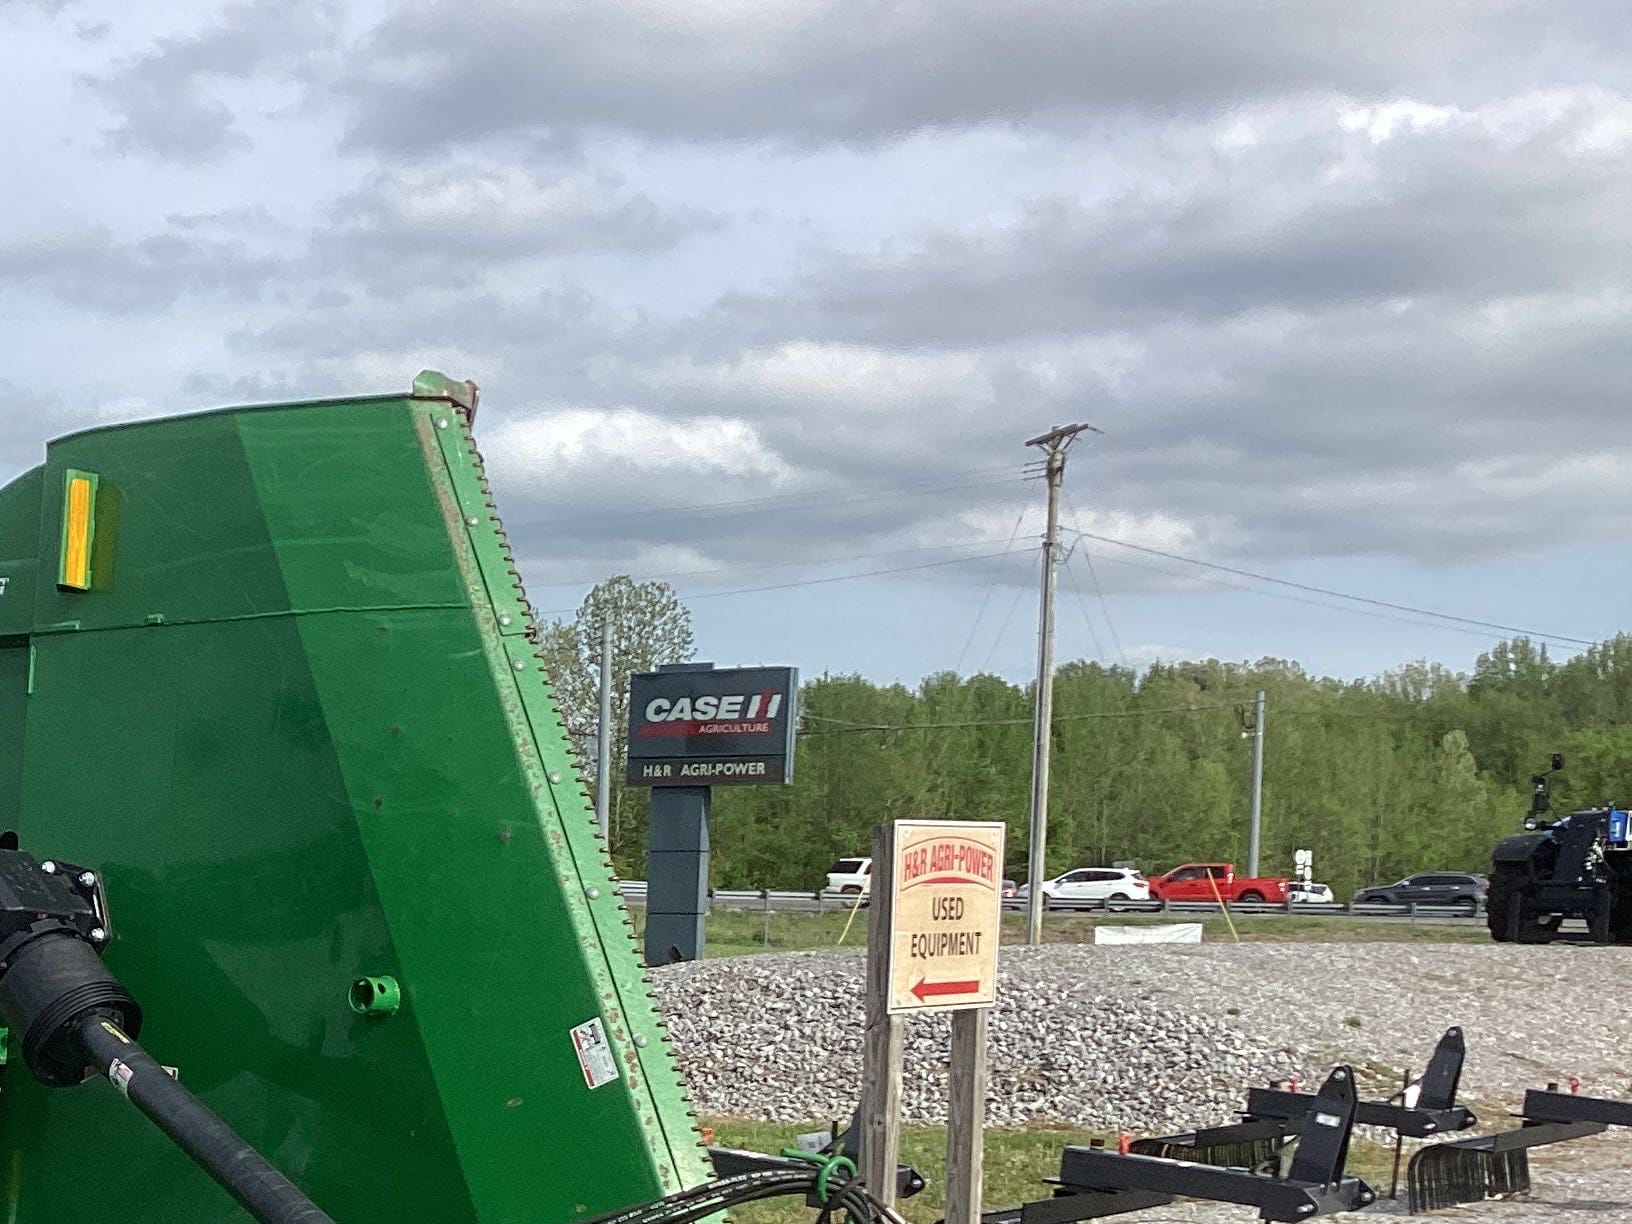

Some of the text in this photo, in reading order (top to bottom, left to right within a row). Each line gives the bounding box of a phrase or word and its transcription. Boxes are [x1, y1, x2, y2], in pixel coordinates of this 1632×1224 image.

[645, 694, 745, 723] CASE
[698, 722, 769, 734] AGRICULTURE
[643, 761, 766, 778] H&R AGRI-POWER
[904, 843, 993, 882] H&R AGRI-POWER
[932, 896, 964, 921] USED
[911, 931, 983, 960] EQUIPMENT
